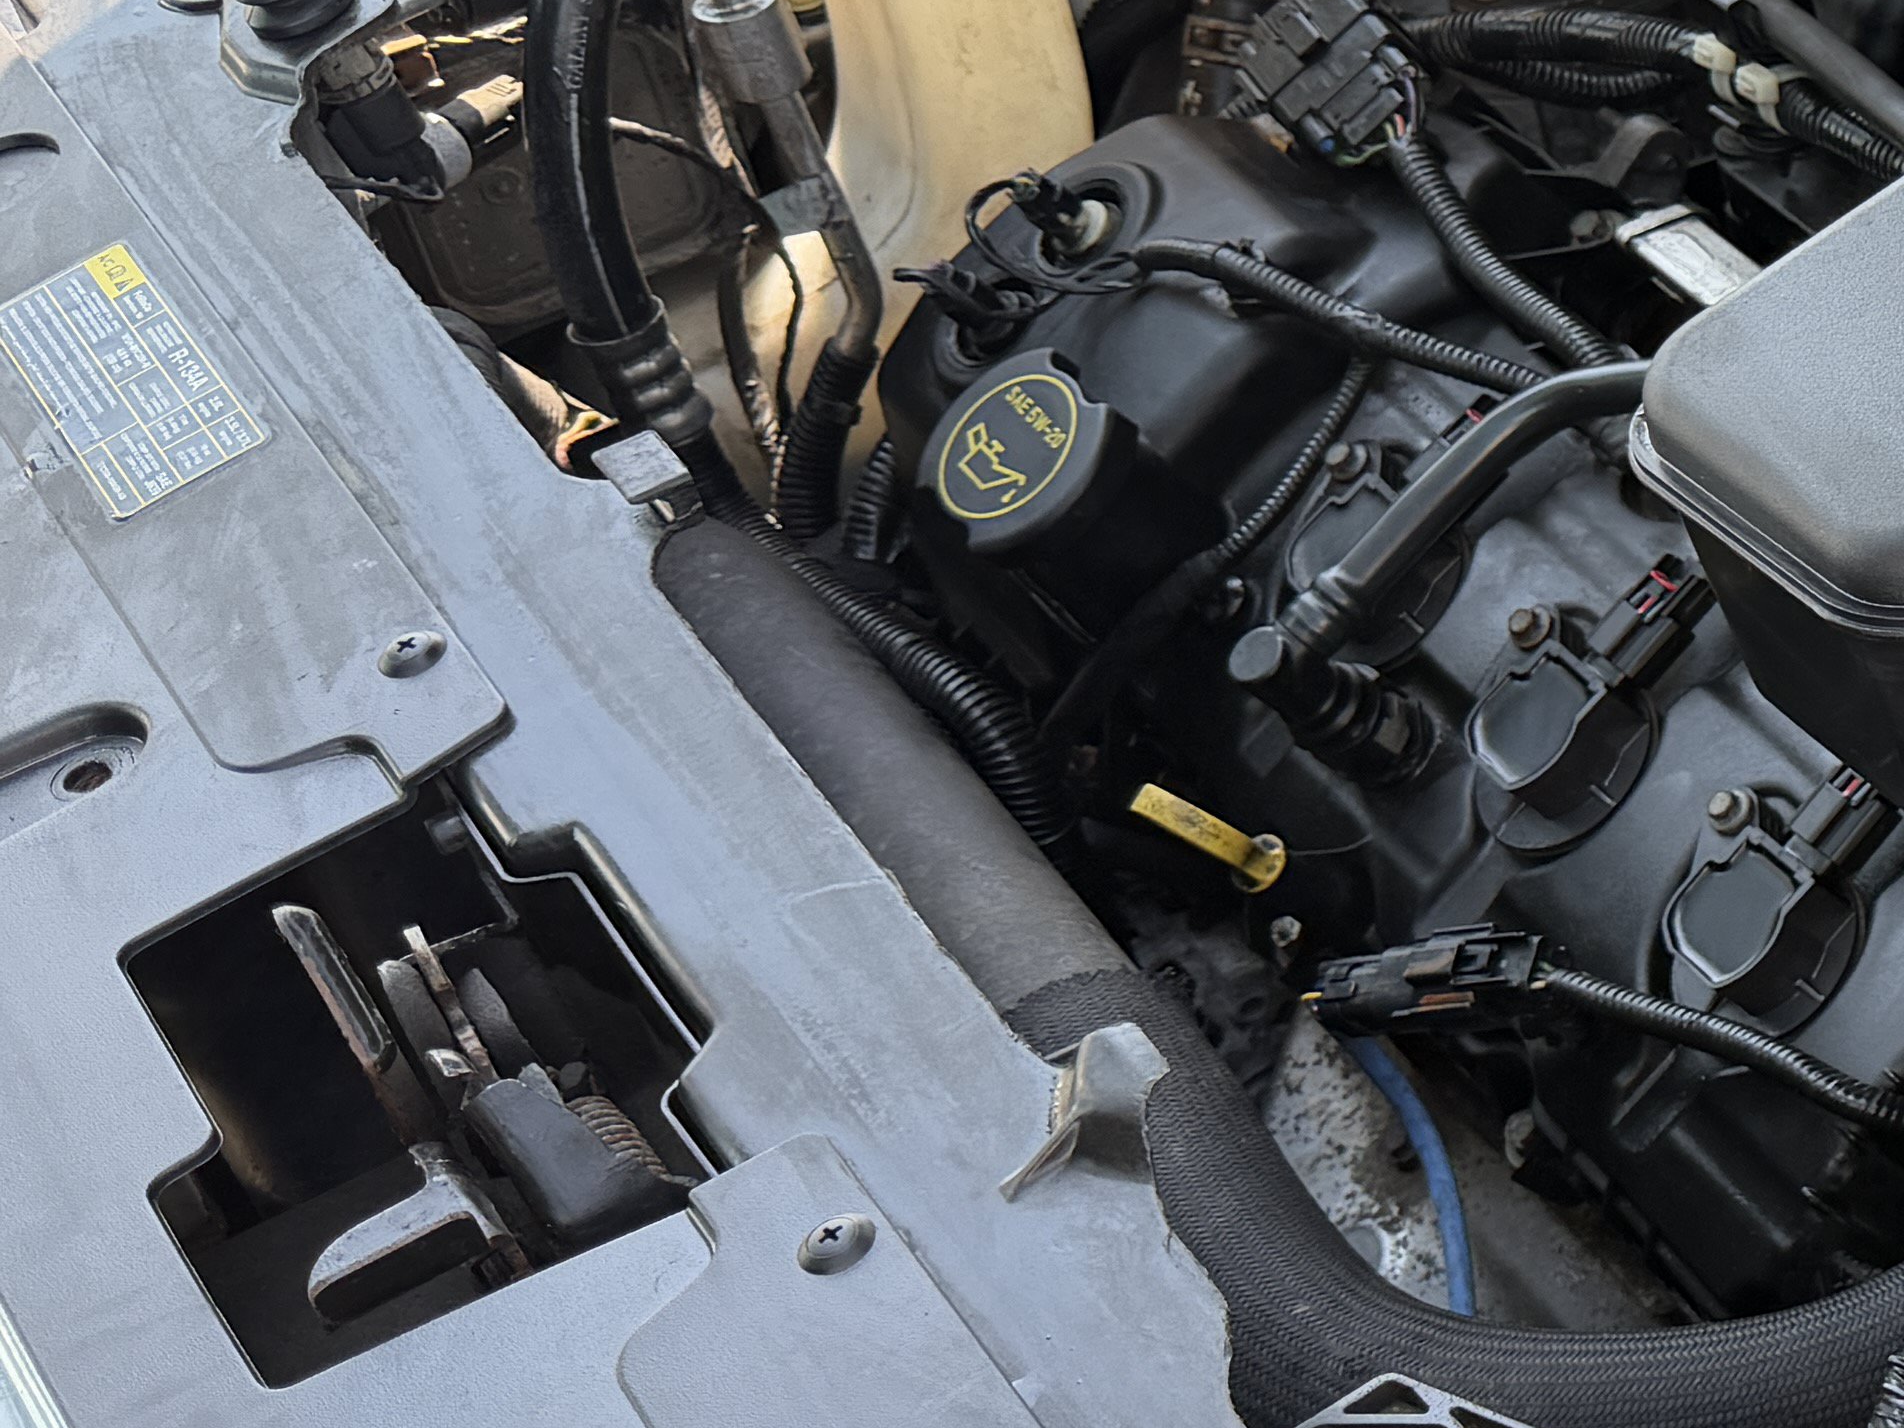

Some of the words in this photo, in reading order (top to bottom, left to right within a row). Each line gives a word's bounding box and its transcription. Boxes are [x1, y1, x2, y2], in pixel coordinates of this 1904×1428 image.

[165, 346, 213, 391] R-134A
[1005, 386, 1033, 415] SAE
[1025, 408, 1067, 449] 5W-20
